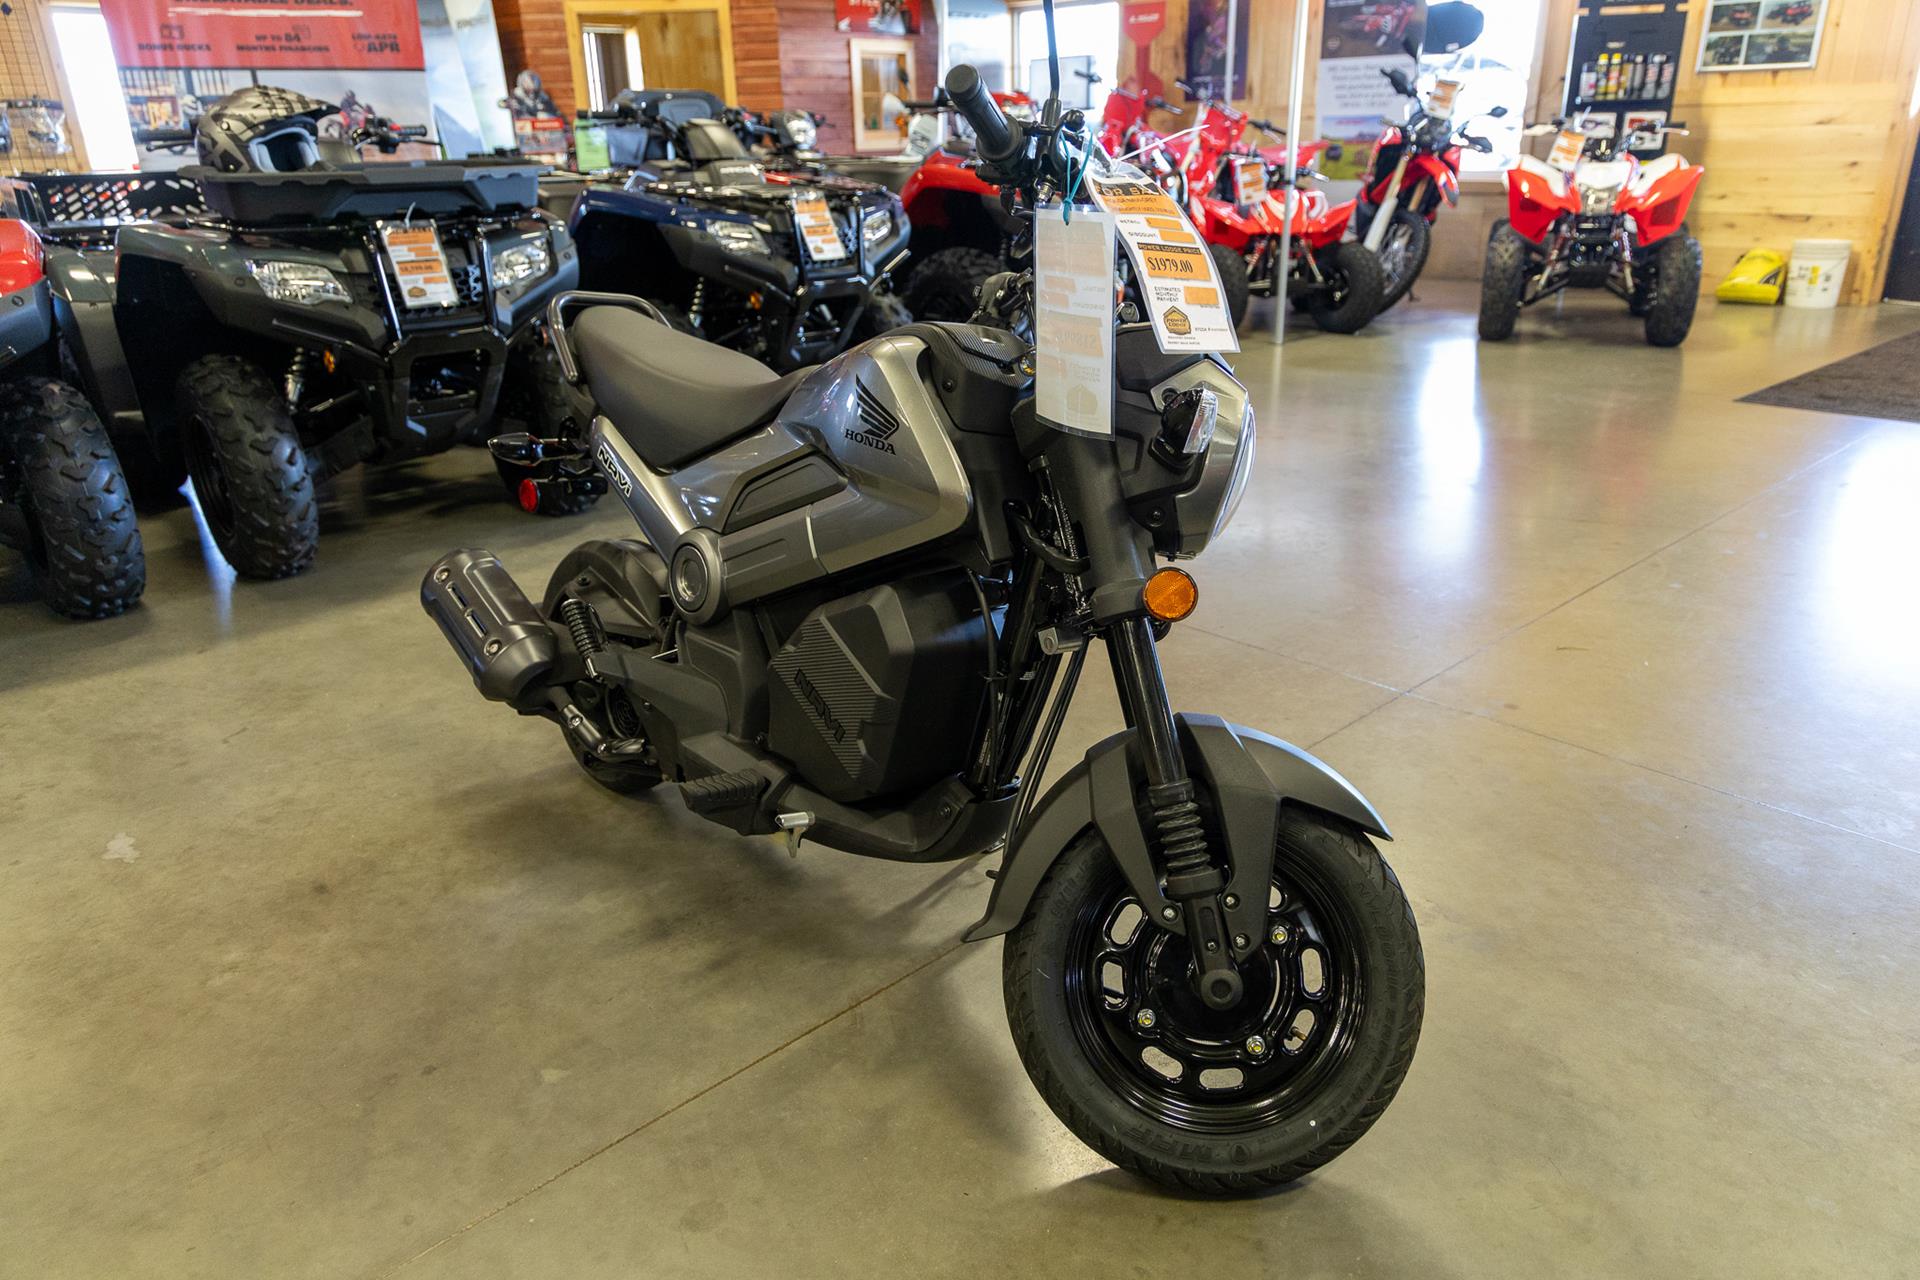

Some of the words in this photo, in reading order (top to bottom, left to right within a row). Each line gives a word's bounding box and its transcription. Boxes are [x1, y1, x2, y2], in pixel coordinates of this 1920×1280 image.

[367, 42, 400, 52] APR
[1095, 184, 1125, 196] FOR
[1161, 246, 1183, 254] LODGE
[1147, 256, 1194, 273] $1979.00
[845, 428, 896, 455] HONDA
